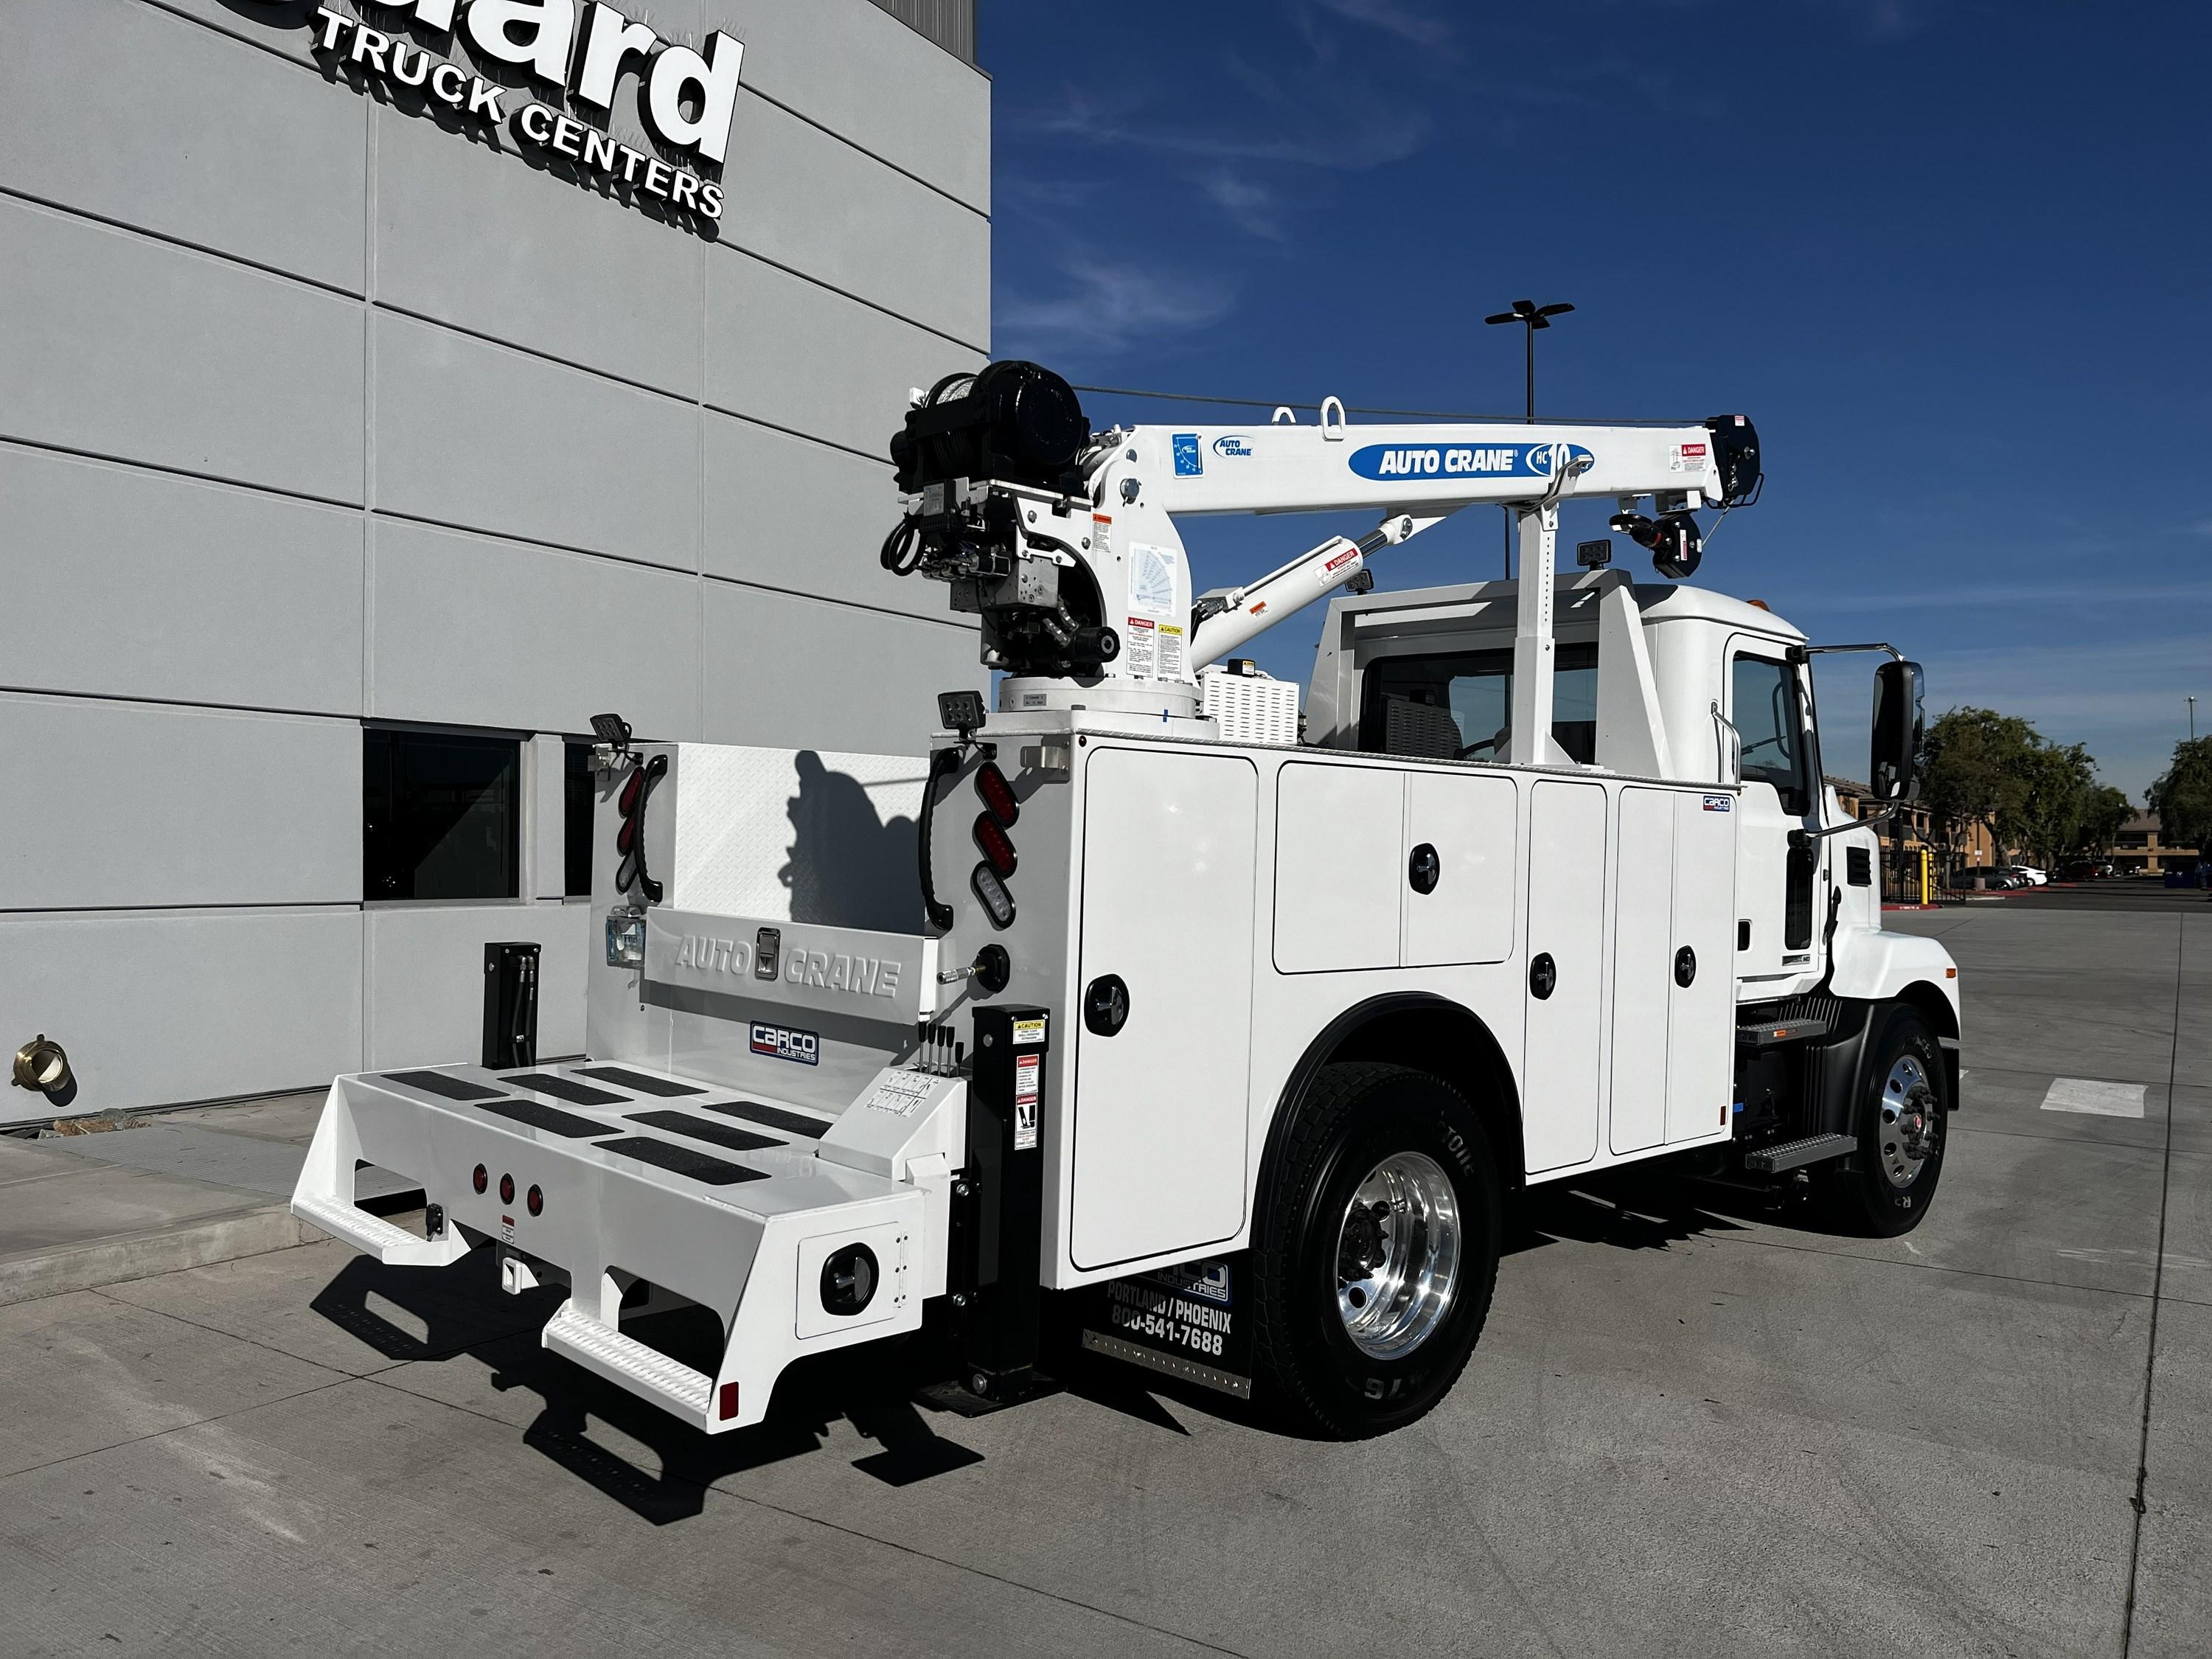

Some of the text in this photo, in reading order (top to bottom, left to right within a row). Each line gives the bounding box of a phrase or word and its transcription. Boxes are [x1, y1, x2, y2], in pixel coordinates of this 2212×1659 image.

[375, 0, 745, 164] ard
[317, 6, 724, 219] TRUCK CENTERS
[1220, 439, 1240, 448] AUTO
[1379, 450, 1439, 474] AUTO
[1536, 451, 1548, 465] HC
[1334, 550, 1355, 566] DANGER
[1134, 619, 1153, 627] DANGER
[675, 935, 901, 998] AUTO CRANE
[777, 1047, 815, 1060] INDUSTRIES
[1158, 1272, 1226, 1298] INDUSTRIES
[1107, 1280, 1166, 1314] PORTLAND
[1175, 1299, 1232, 1334] PHOENIX
[1112, 1304, 1222, 1356] 800-541-7688
